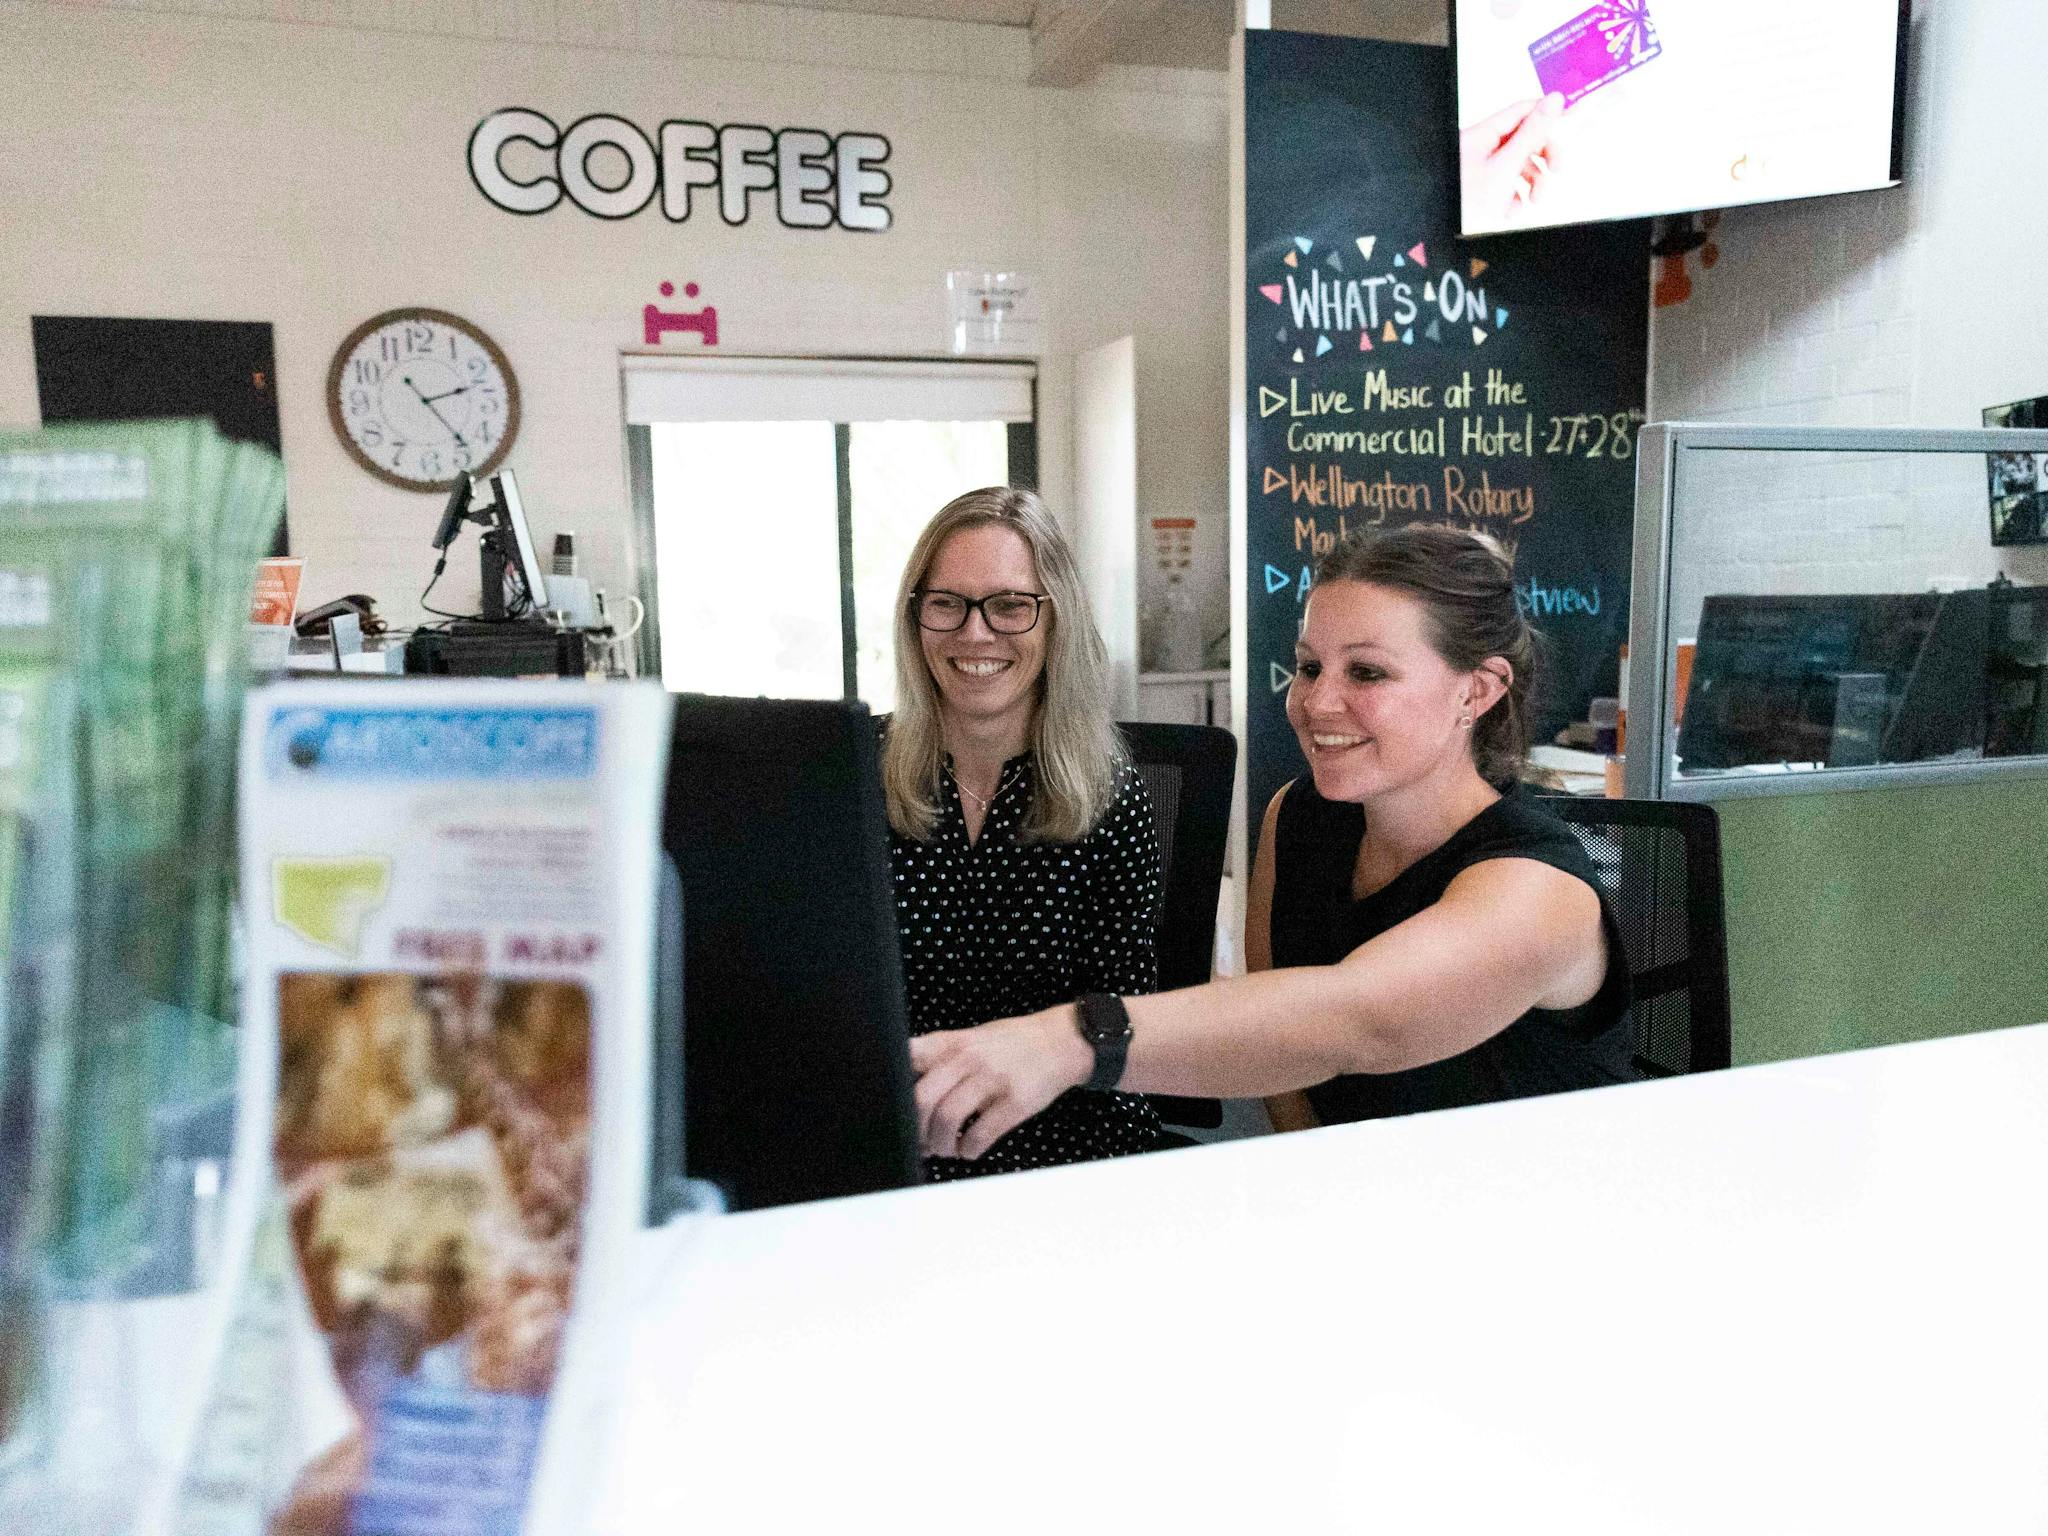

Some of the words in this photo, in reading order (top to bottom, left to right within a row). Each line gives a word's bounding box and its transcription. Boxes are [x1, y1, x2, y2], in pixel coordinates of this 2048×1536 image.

[467, 107, 892, 232] COFFEE
[1286, 268, 1418, 331] WHAT'S
[380, 336, 398, 361] 11
[405, 326, 434, 352] 12
[355, 359, 381, 385] 10
[468, 357, 487, 384] 2
[350, 389, 370, 416] 9
[1290, 377, 1355, 417] Live
[1364, 368, 1433, 412] Music
[1444, 371, 1475, 408] at
[1484, 368, 1527, 406] the
[362, 420, 383, 448] 8
[1287, 417, 1445, 458] Commercial
[1462, 412, 1533, 457] Hotel
[392, 441, 406, 467] 7
[1290, 463, 1432, 525] Wellington
[1443, 465, 1534, 524] Rotary
